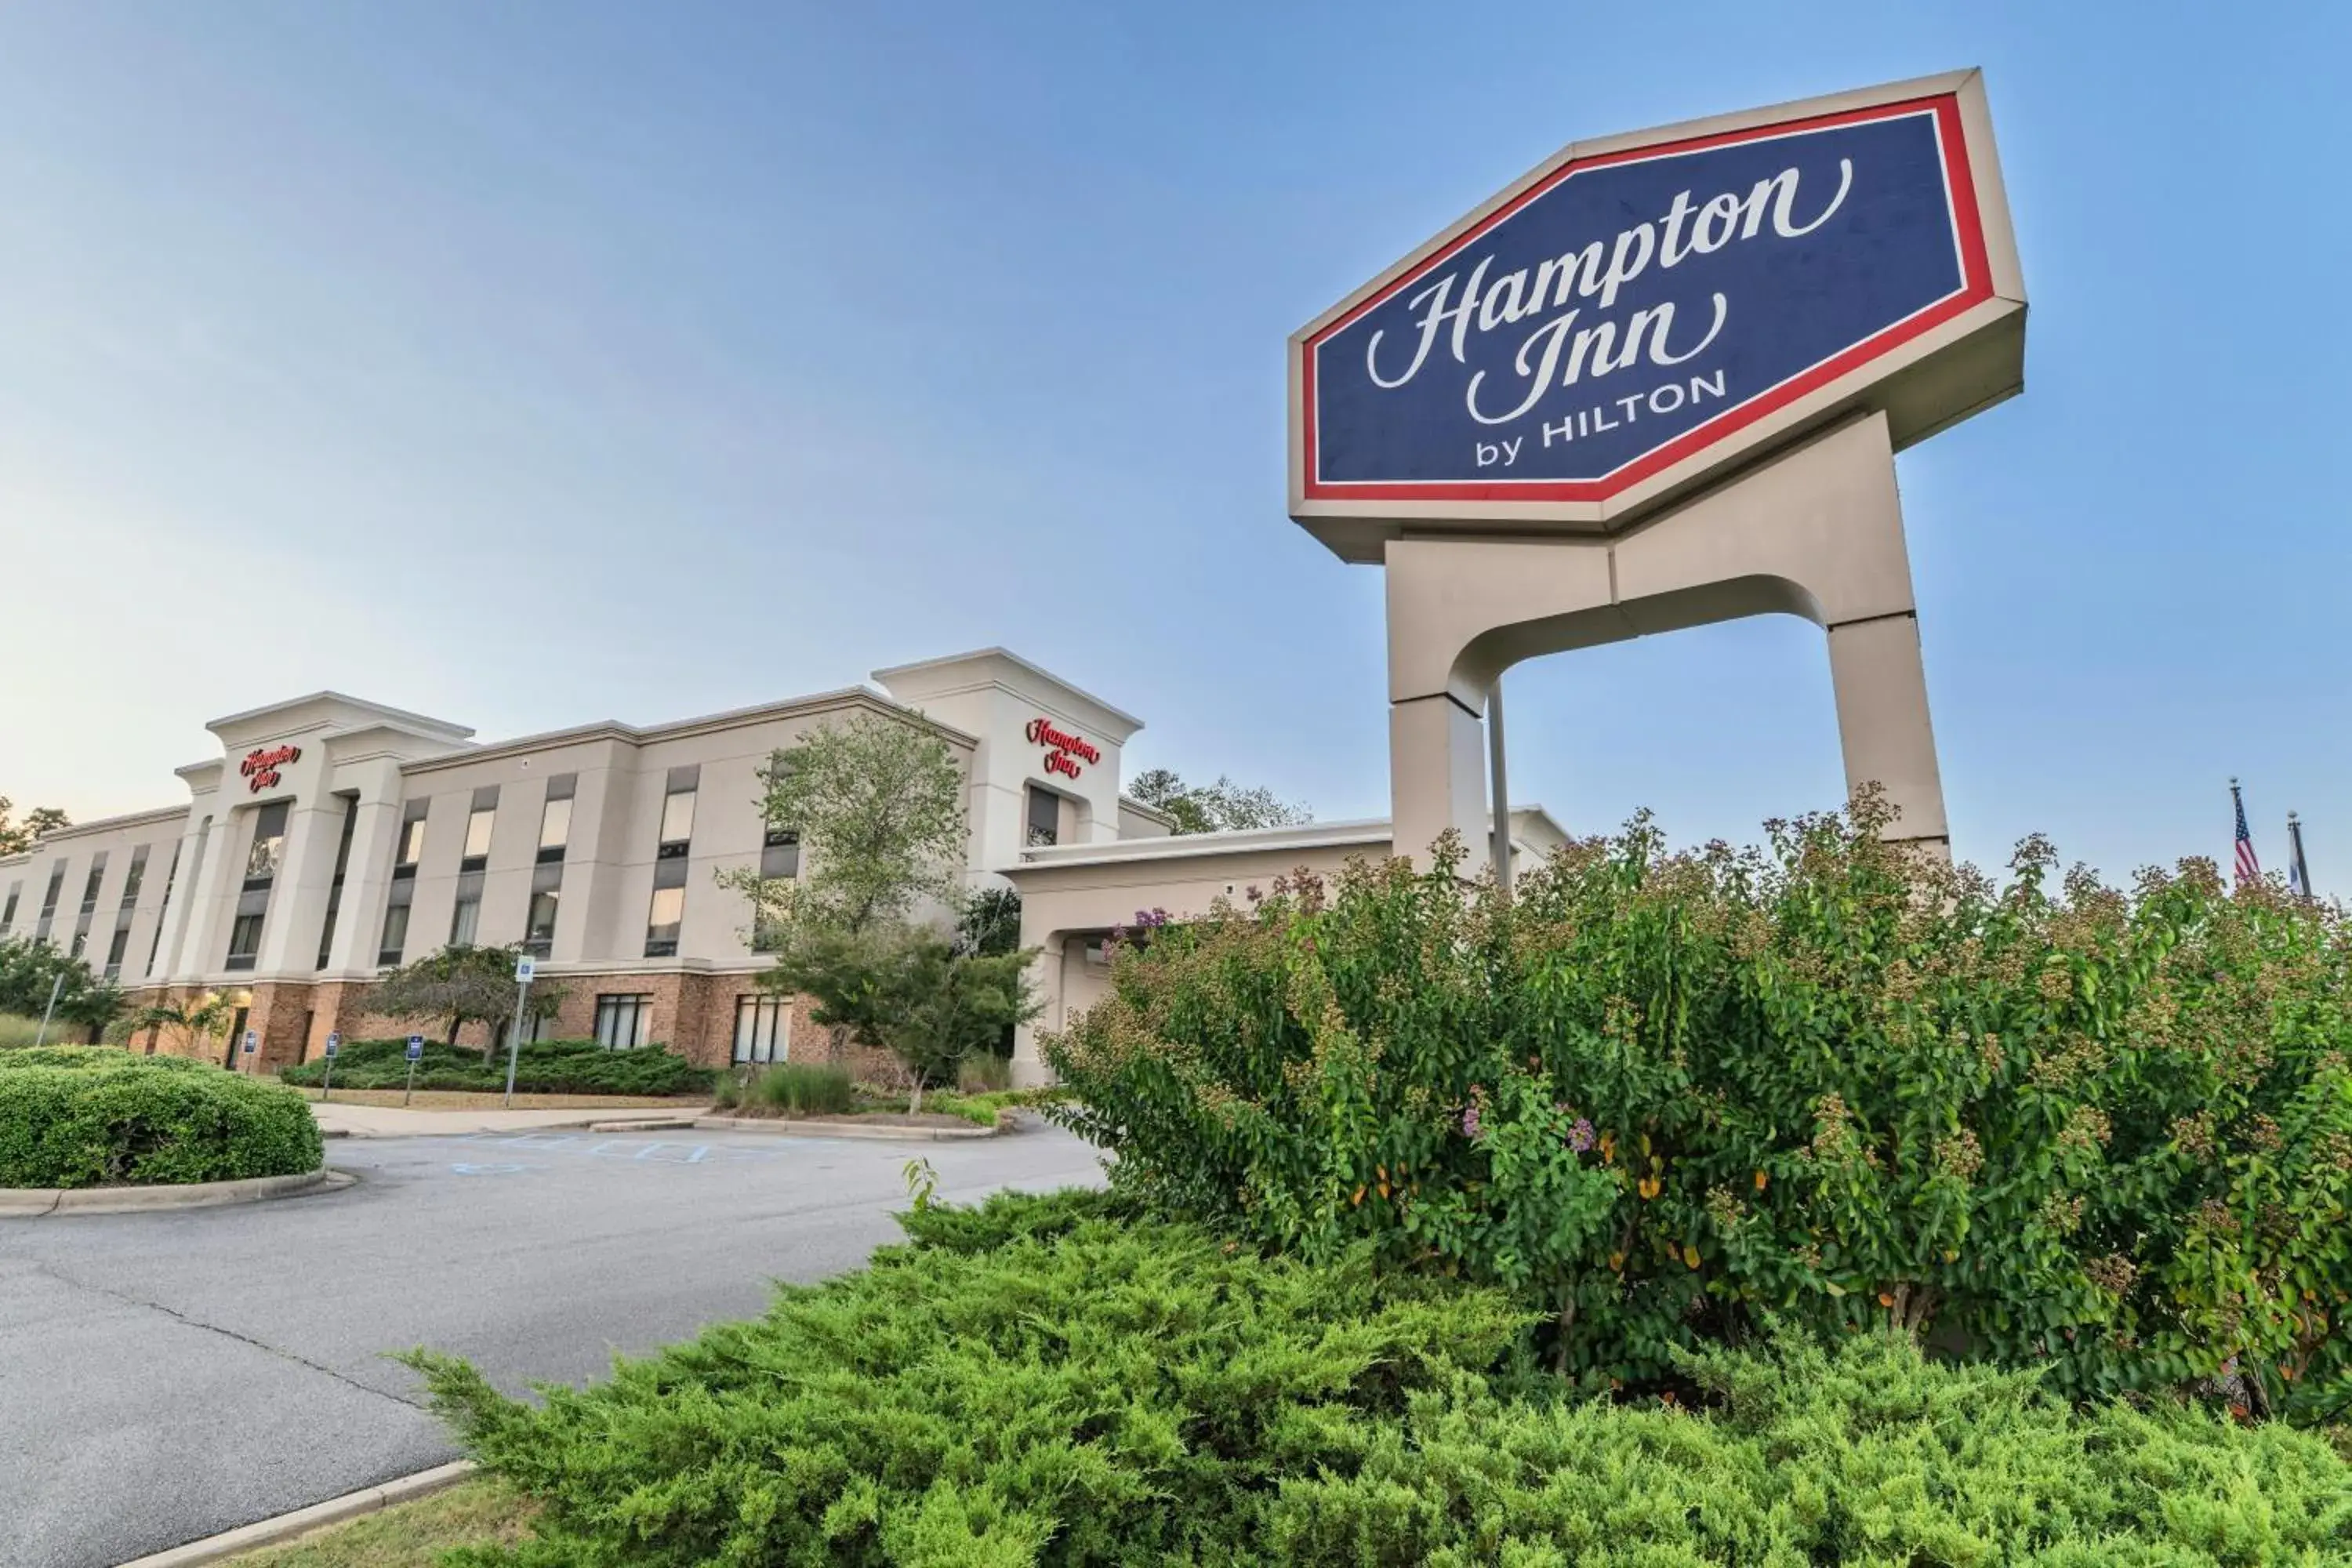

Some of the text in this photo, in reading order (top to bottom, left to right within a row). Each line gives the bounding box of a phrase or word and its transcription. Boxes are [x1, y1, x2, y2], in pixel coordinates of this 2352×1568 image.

[1367, 158, 1853, 388] Hampton
[1467, 292, 1727, 424] Inn
[1475, 368, 1726, 468] by HILTON
[1025, 718, 1100, 764] Hampton
[1044, 749, 1081, 779] Inn
